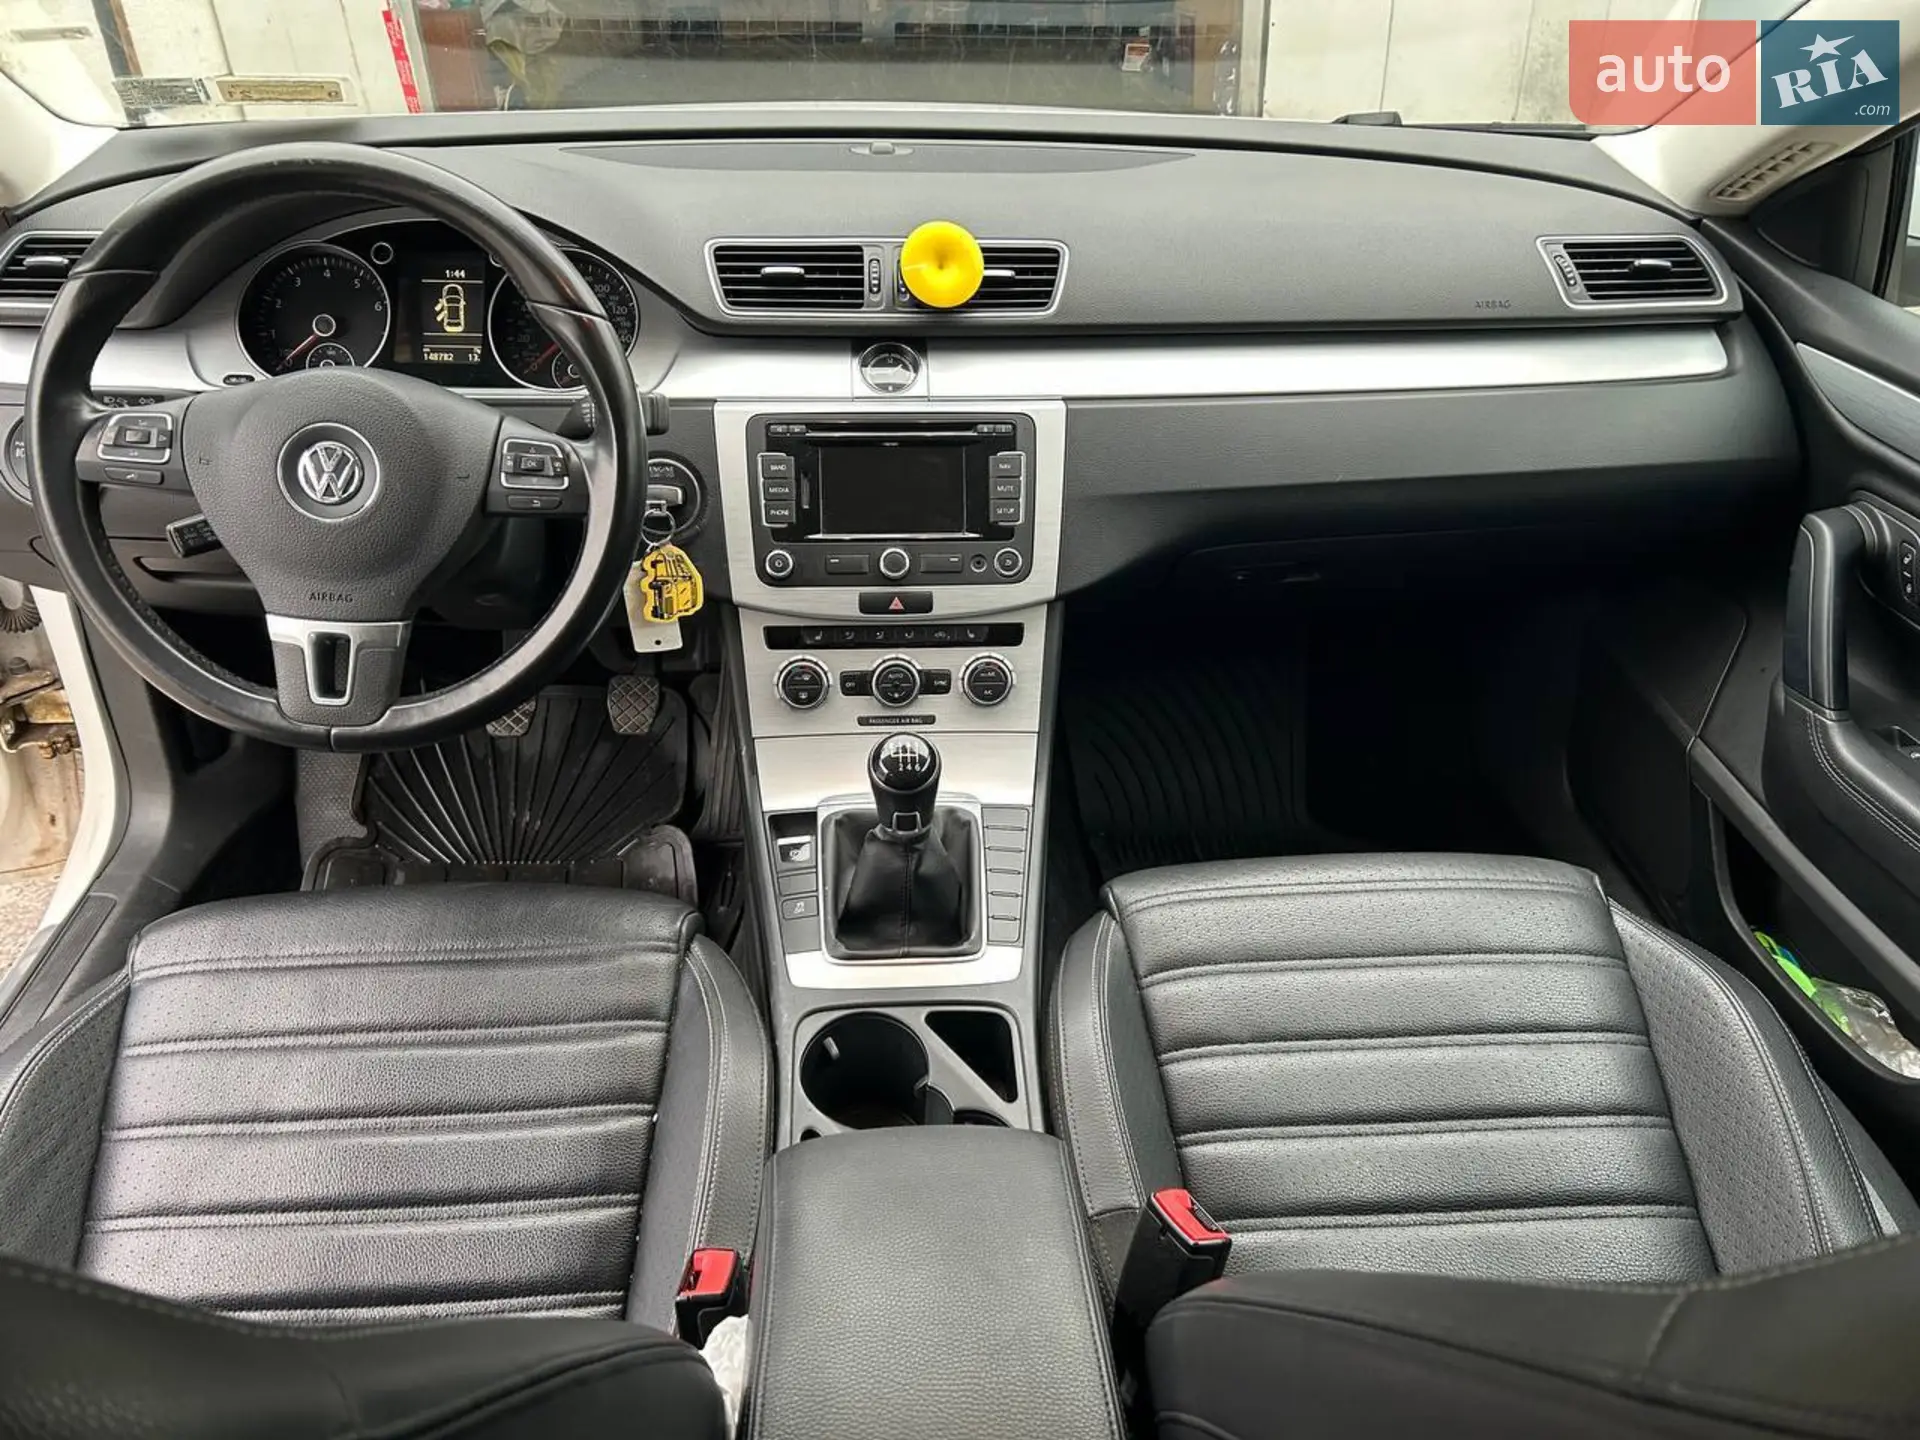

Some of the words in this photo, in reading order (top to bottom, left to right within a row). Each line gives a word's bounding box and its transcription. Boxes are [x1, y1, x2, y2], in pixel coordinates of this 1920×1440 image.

[323, 269, 331, 278] 4
[445, 269, 466, 278] 1:44
[294, 277, 301, 287] 3
[353, 279, 361, 288] 5
[374, 301, 382, 311] 6
[1475, 300, 1511, 309] AIRBAG
[308, 592, 354, 603] AIRBAG
[914, 763, 921, 772] 6
